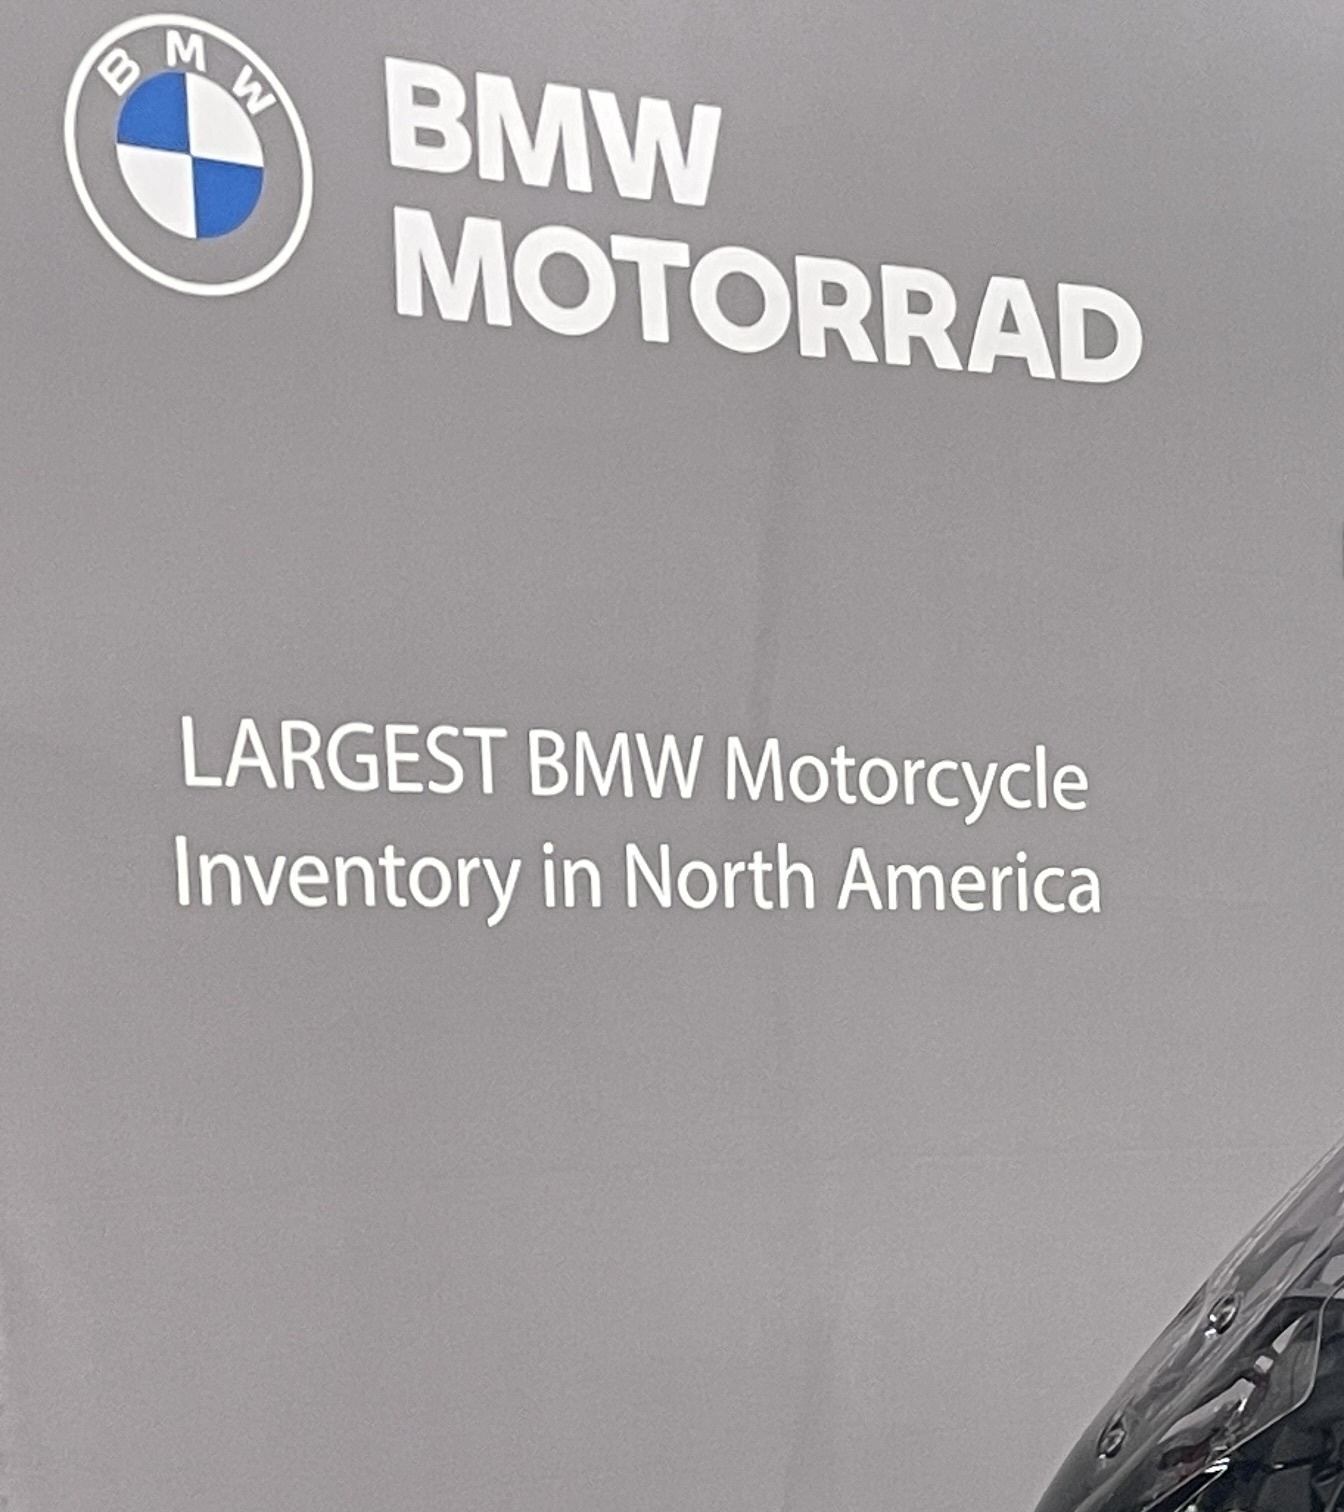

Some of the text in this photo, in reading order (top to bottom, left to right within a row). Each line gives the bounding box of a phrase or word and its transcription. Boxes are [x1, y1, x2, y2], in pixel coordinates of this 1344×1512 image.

[98, 30, 276, 114] BMW
[385, 57, 721, 205] BMW
[394, 207, 1142, 382] MOTORRAD
[182, 716, 1087, 825] LARGEST BMW Motorcycle
[176, 836, 1100, 927] Inventory in North America
